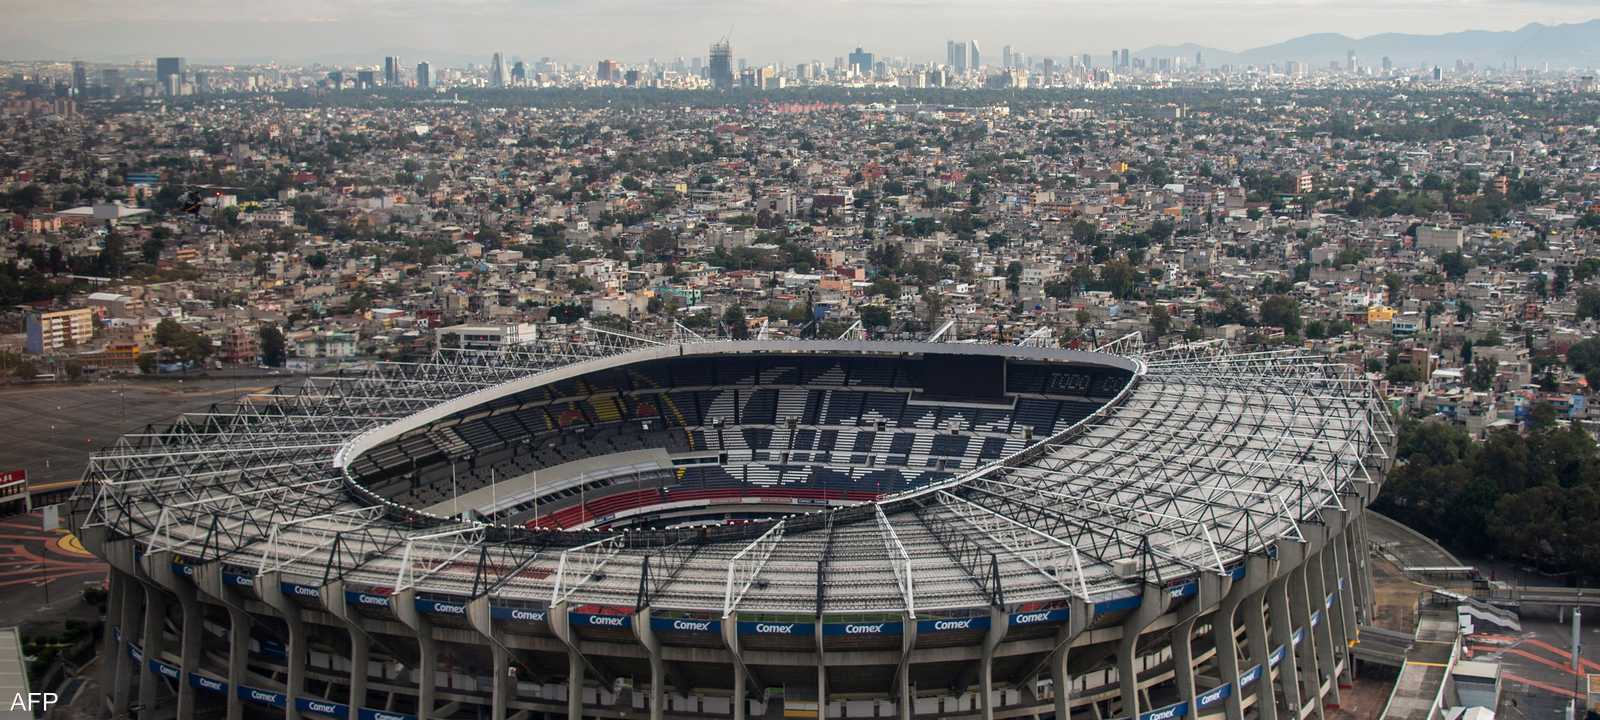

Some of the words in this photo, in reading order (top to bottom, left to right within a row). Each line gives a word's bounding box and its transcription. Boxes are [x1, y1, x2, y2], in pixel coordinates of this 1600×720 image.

[359, 594, 389, 605] Comex
[434, 603, 466, 614] Comex
[512, 610, 544, 621] Comex
[590, 616, 624, 626] Comex
[1016, 611, 1049, 624] Comex
[674, 620, 711, 631] Comex
[756, 624, 794, 633] Comex
[846, 624, 883, 634] Comex
[935, 619, 971, 630] Comex
[200, 678, 221, 690] Comex
[252, 690, 277, 702] Comex
[1202, 691, 1221, 705] Comex
[309, 702, 336, 713] Comex
